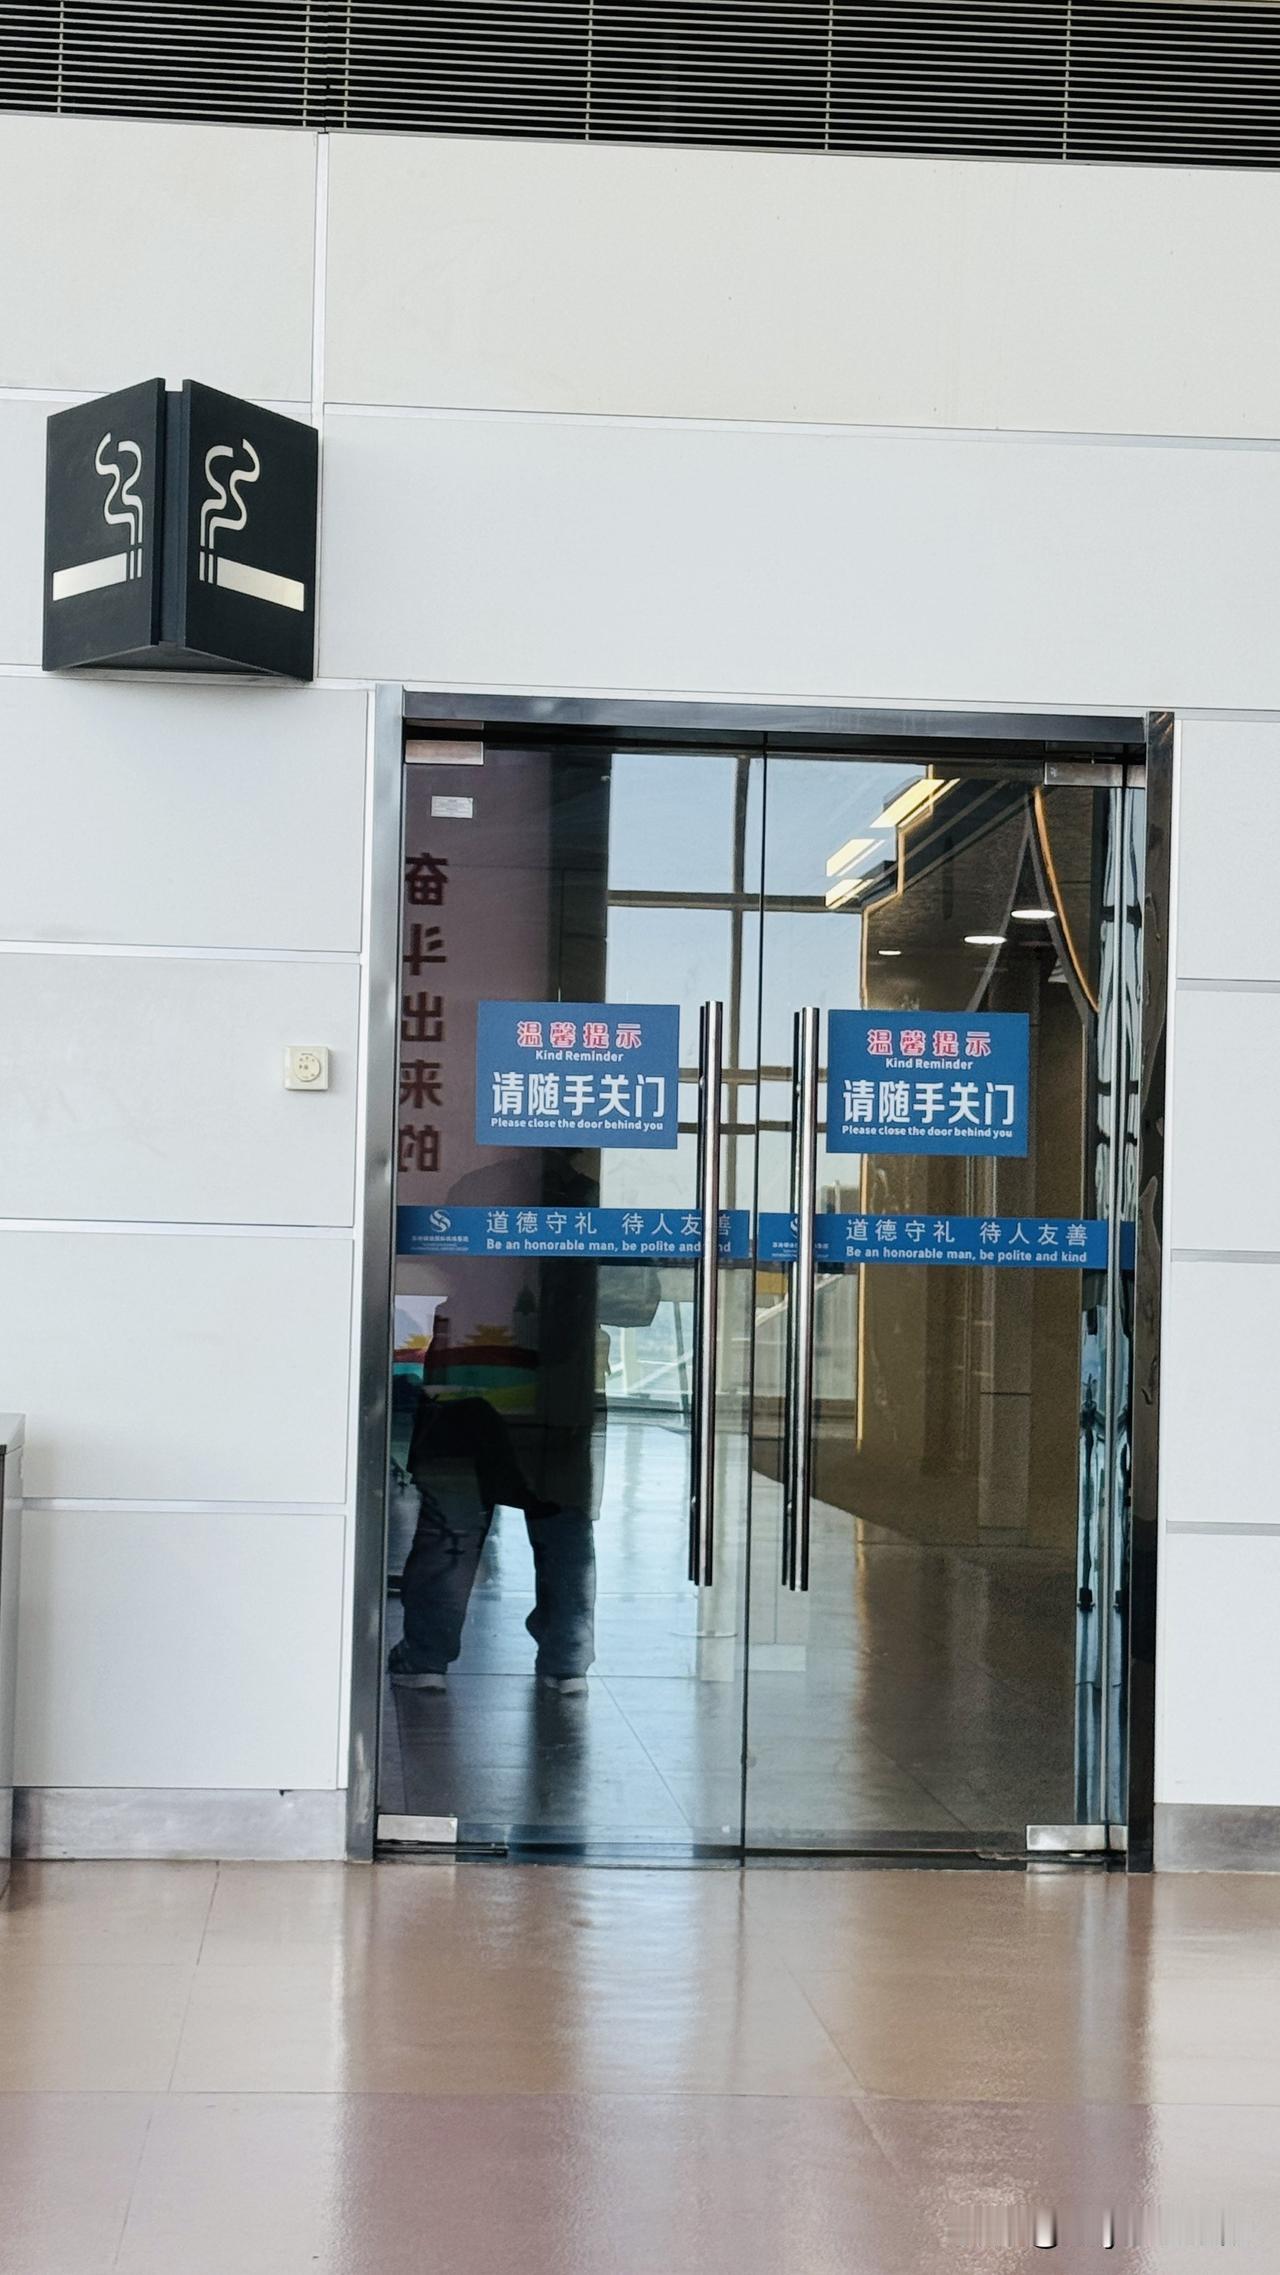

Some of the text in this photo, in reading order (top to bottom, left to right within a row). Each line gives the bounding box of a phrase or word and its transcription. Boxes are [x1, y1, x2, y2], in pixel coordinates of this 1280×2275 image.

[517, 1021, 641, 1049] 温馨提示
[867, 1029, 991, 1057] 温馨提示
[536, 1050, 623, 1062] Kind Reminder
[886, 1058, 973, 1070] Kind Reminder
[492, 1072, 665, 1118] 请随手关门
[843, 1079, 1015, 1126] 请随手关门
[491, 1118, 663, 1133] Please close the door behind you
[842, 1125, 1012, 1140] Please close the door behind you
[487, 1211, 597, 1234] 道德守礼
[846, 1219, 1088, 1247] 道德守礼 待人友善
[487, 1239, 502, 1250] Be
[506, 1241, 520, 1250] an
[525, 1239, 584, 1251] honorable
[589, 1243, 618, 1253] man,
[622, 1240, 637, 1252] be
[641, 1241, 675, 1254] polite
[679, 1241, 701, 1253] and
[847, 1246, 1087, 1263] Be an honorable man, be polite and kind
